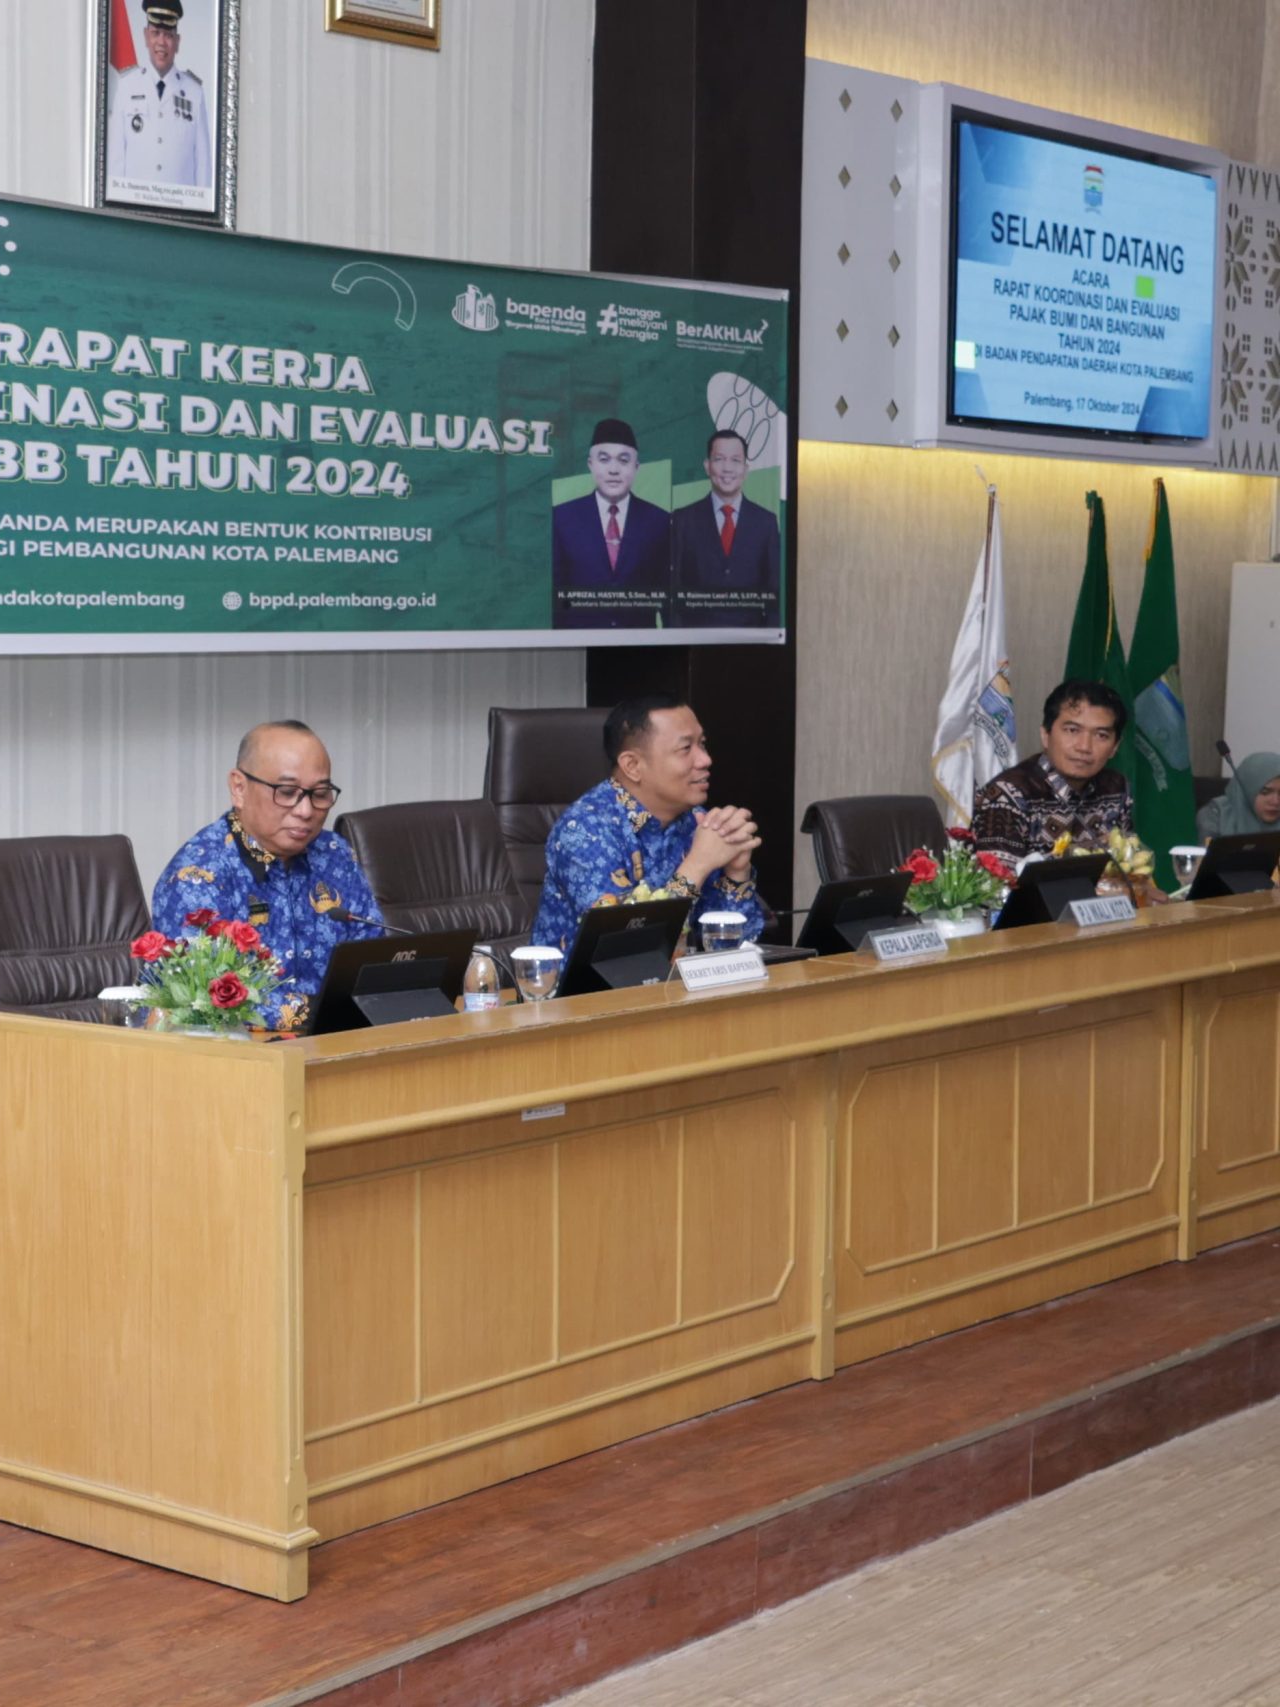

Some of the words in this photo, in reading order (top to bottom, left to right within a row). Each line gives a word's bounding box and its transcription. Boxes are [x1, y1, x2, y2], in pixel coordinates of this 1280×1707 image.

[990, 210, 1096, 260] SELAMAT
[1102, 231, 1185, 275] DATANG
[1072, 268, 1110, 289] ACARA
[506, 297, 586, 322] bapenda
[619, 305, 661, 319] bangga
[993, 278, 1030, 299] RAPAT
[1034, 284, 1103, 311] KOORDINASI
[1106, 296, 1128, 315] DAN
[1131, 299, 1180, 322] EVALUASI
[619, 326, 659, 342] bangsa
[620, 317, 668, 332] melayani
[676, 319, 763, 345] BerAKHLAK
[1009, 303, 1046, 325] PAJAK
[1050, 309, 1078, 329] BUMI
[1080, 313, 1103, 332] DAN
[1106, 317, 1165, 340] BANGUNAN
[1058, 332, 1095, 353] TAHUN
[1097, 338, 1121, 356] 2024
[200, 341, 375, 395] KERJA
[974, 343, 983, 358] DI
[985, 345, 1018, 362] BADAN
[1020, 350, 1079, 369] PENDAPATAN
[1081, 357, 1118, 374] DAERAH
[1119, 362, 1142, 377] KOTA
[1144, 365, 1194, 383] PALEMBANG
[1076, 398, 1086, 411] 17
[1088, 398, 1120, 414] Oktober
[1121, 402, 1140, 415] 2024
[180, 394, 301, 442] DAN
[310, 404, 554, 457] EVALUASI
[76, 443, 277, 494] TAHUN
[286, 456, 412, 499] 2024
[75, 516, 219, 537] MERUPAKAN
[224, 521, 309, 539] BENTUK
[314, 524, 433, 543] KONTRIBUSI
[23, 539, 206, 560] PEMBANGUNAN
[211, 545, 269, 561] KOTA
[274, 546, 399, 564] PALEMBANG
[248, 591, 437, 610] bppd.palembang.go.id
[391, 950, 417, 963] AOC
[880, 936, 909, 956] KEPALA
[684, 965, 728, 980] SEKRETARIS
[728, 959, 761, 976] BAPENDA
